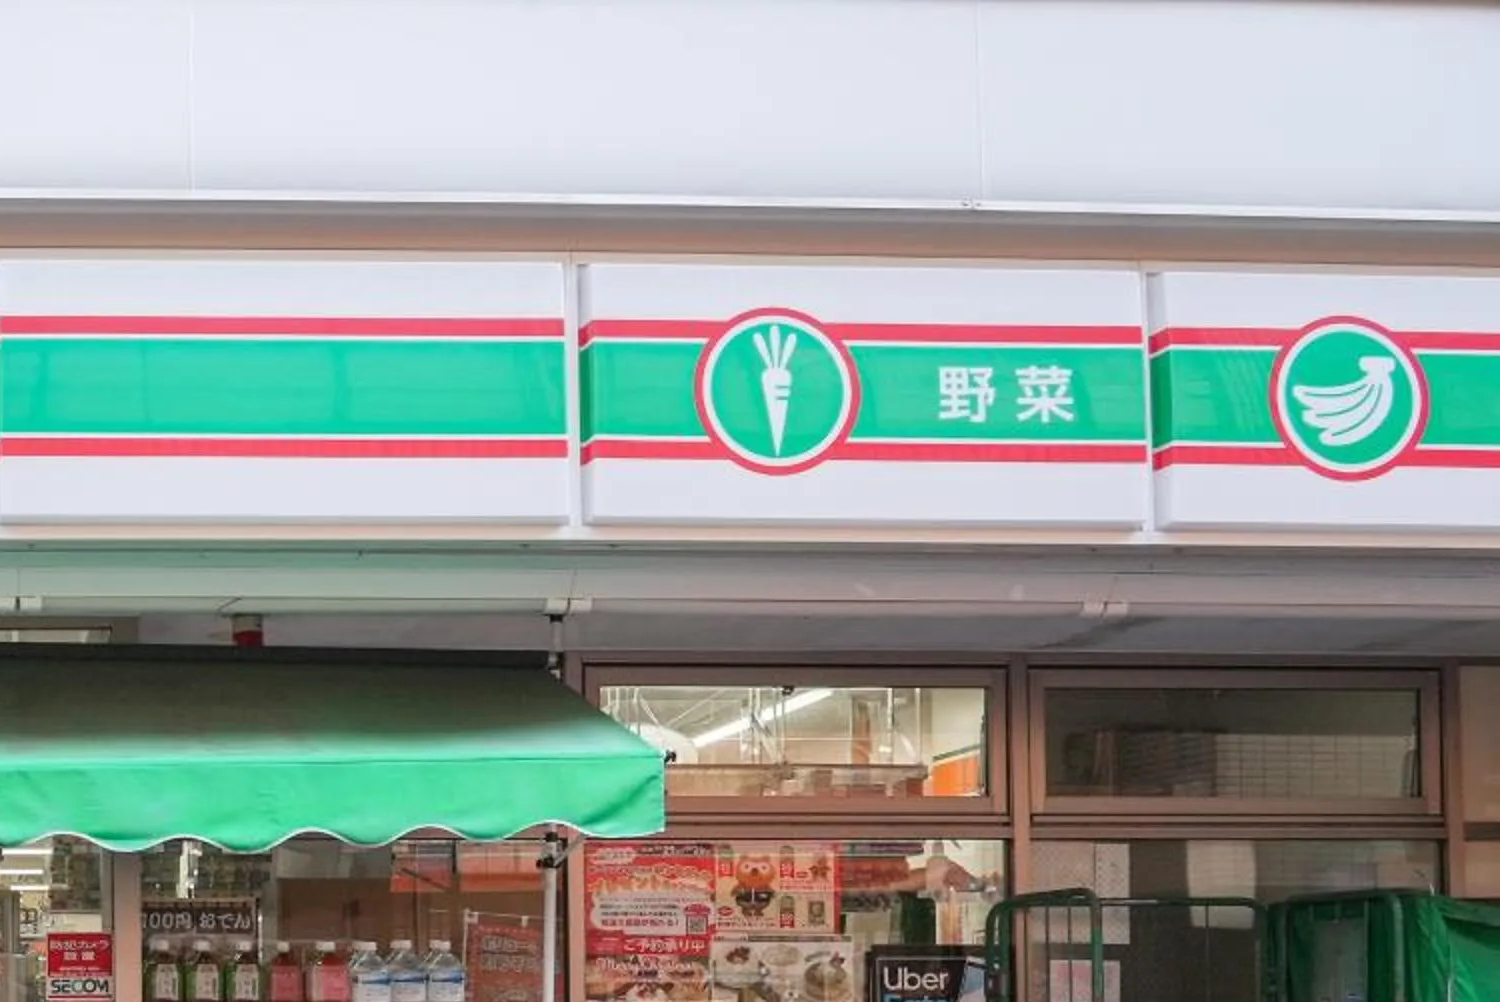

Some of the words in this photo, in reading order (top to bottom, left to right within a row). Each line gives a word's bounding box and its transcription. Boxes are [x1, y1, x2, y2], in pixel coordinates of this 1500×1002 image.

[937, 365, 1074, 423] 野菜
[52, 979, 109, 993] SECOM
[883, 967, 949, 991] Uber
